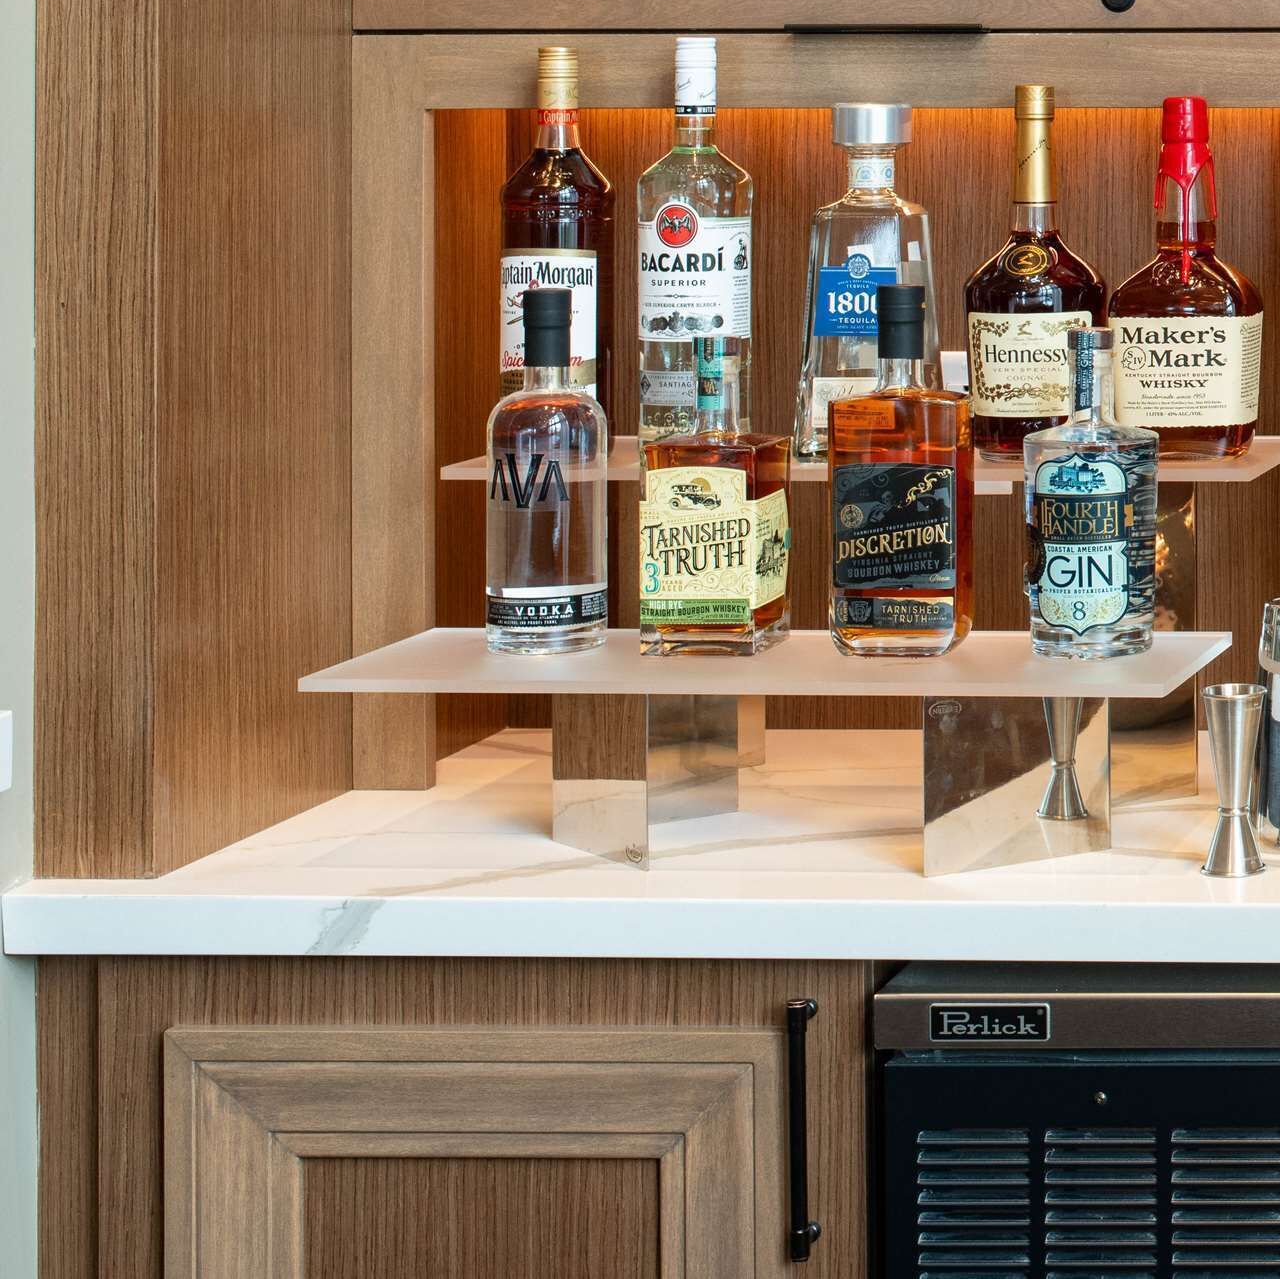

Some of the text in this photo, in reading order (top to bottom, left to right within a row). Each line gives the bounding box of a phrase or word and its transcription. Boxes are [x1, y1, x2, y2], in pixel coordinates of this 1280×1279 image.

[543, 109, 570, 124] Captain
[641, 246, 724, 273] BACARDÍ
[532, 261, 593, 289] Morgan
[650, 279, 707, 287] SUPERIOR
[838, 317, 876, 325] TEQUILA
[1120, 326, 1226, 345] Maker's
[985, 344, 1068, 366] Hennessy
[1080, 348, 1089, 368] GIN
[1147, 349, 1227, 368] Mark
[1140, 379, 1209, 389] WHISKY
[1042, 498, 1118, 520] FOURTH
[1040, 519, 1119, 537] HANDLE
[640, 518, 751, 561] TARNISHED
[835, 521, 953, 564] DISCRETION
[1047, 545, 1113, 553] COASTAL AMERICAN
[659, 540, 746, 576] TRUTH
[852, 551, 934, 566] VIRGINIA STRAIGHT
[644, 563, 660, 593] 3
[847, 560, 940, 578] BOURBON WHISKEY
[1046, 554, 1113, 588] GIN
[514, 605, 575, 617] VODKA
[641, 607, 676, 617] STRAIGHT
[677, 605, 710, 616] BOURBON
[712, 604, 747, 615] WHISKEY
[650, 600, 683, 609] HIGH RYE
[881, 605, 940, 615] TARNISHED
[1072, 600, 1087, 621] 8
[893, 614, 928, 623] TRUTH
[939, 1011, 1039, 1035] Perlick
